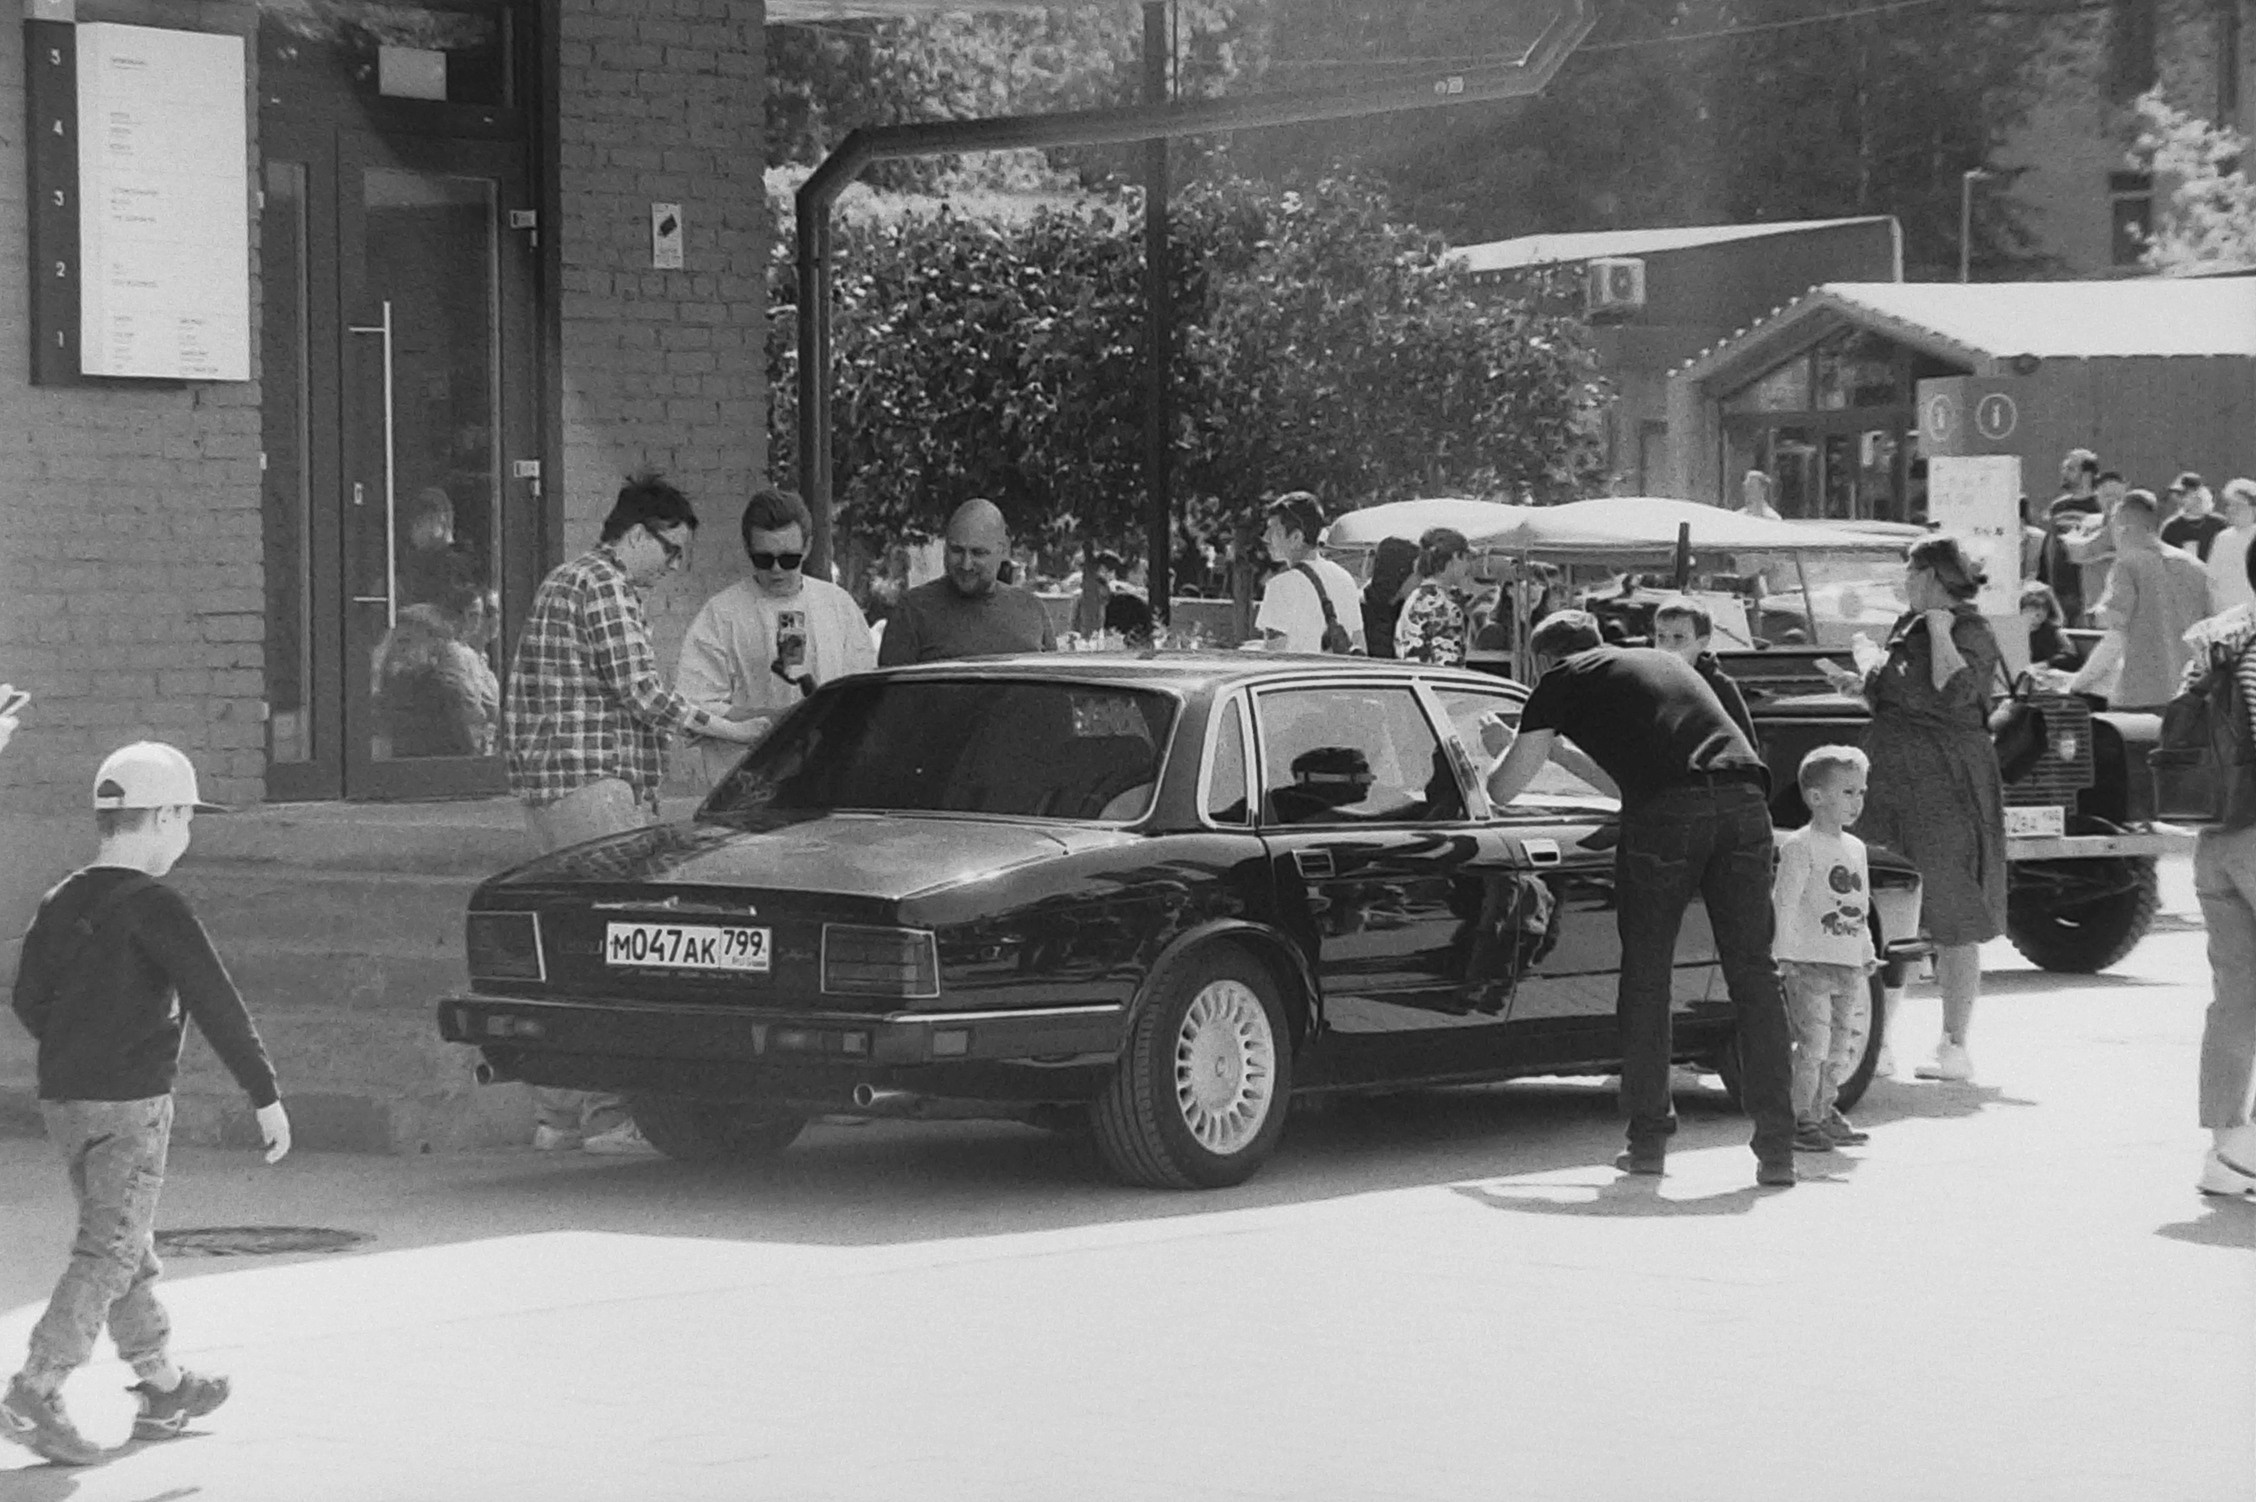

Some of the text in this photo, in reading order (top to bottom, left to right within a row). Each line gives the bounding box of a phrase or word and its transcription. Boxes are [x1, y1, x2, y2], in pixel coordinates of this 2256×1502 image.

[53, 120, 63, 136] 4
[54, 190, 64, 206] 3
[56, 261, 65, 277] 2
[57, 330, 64, 347] 1
[723, 929, 763, 956] 799
